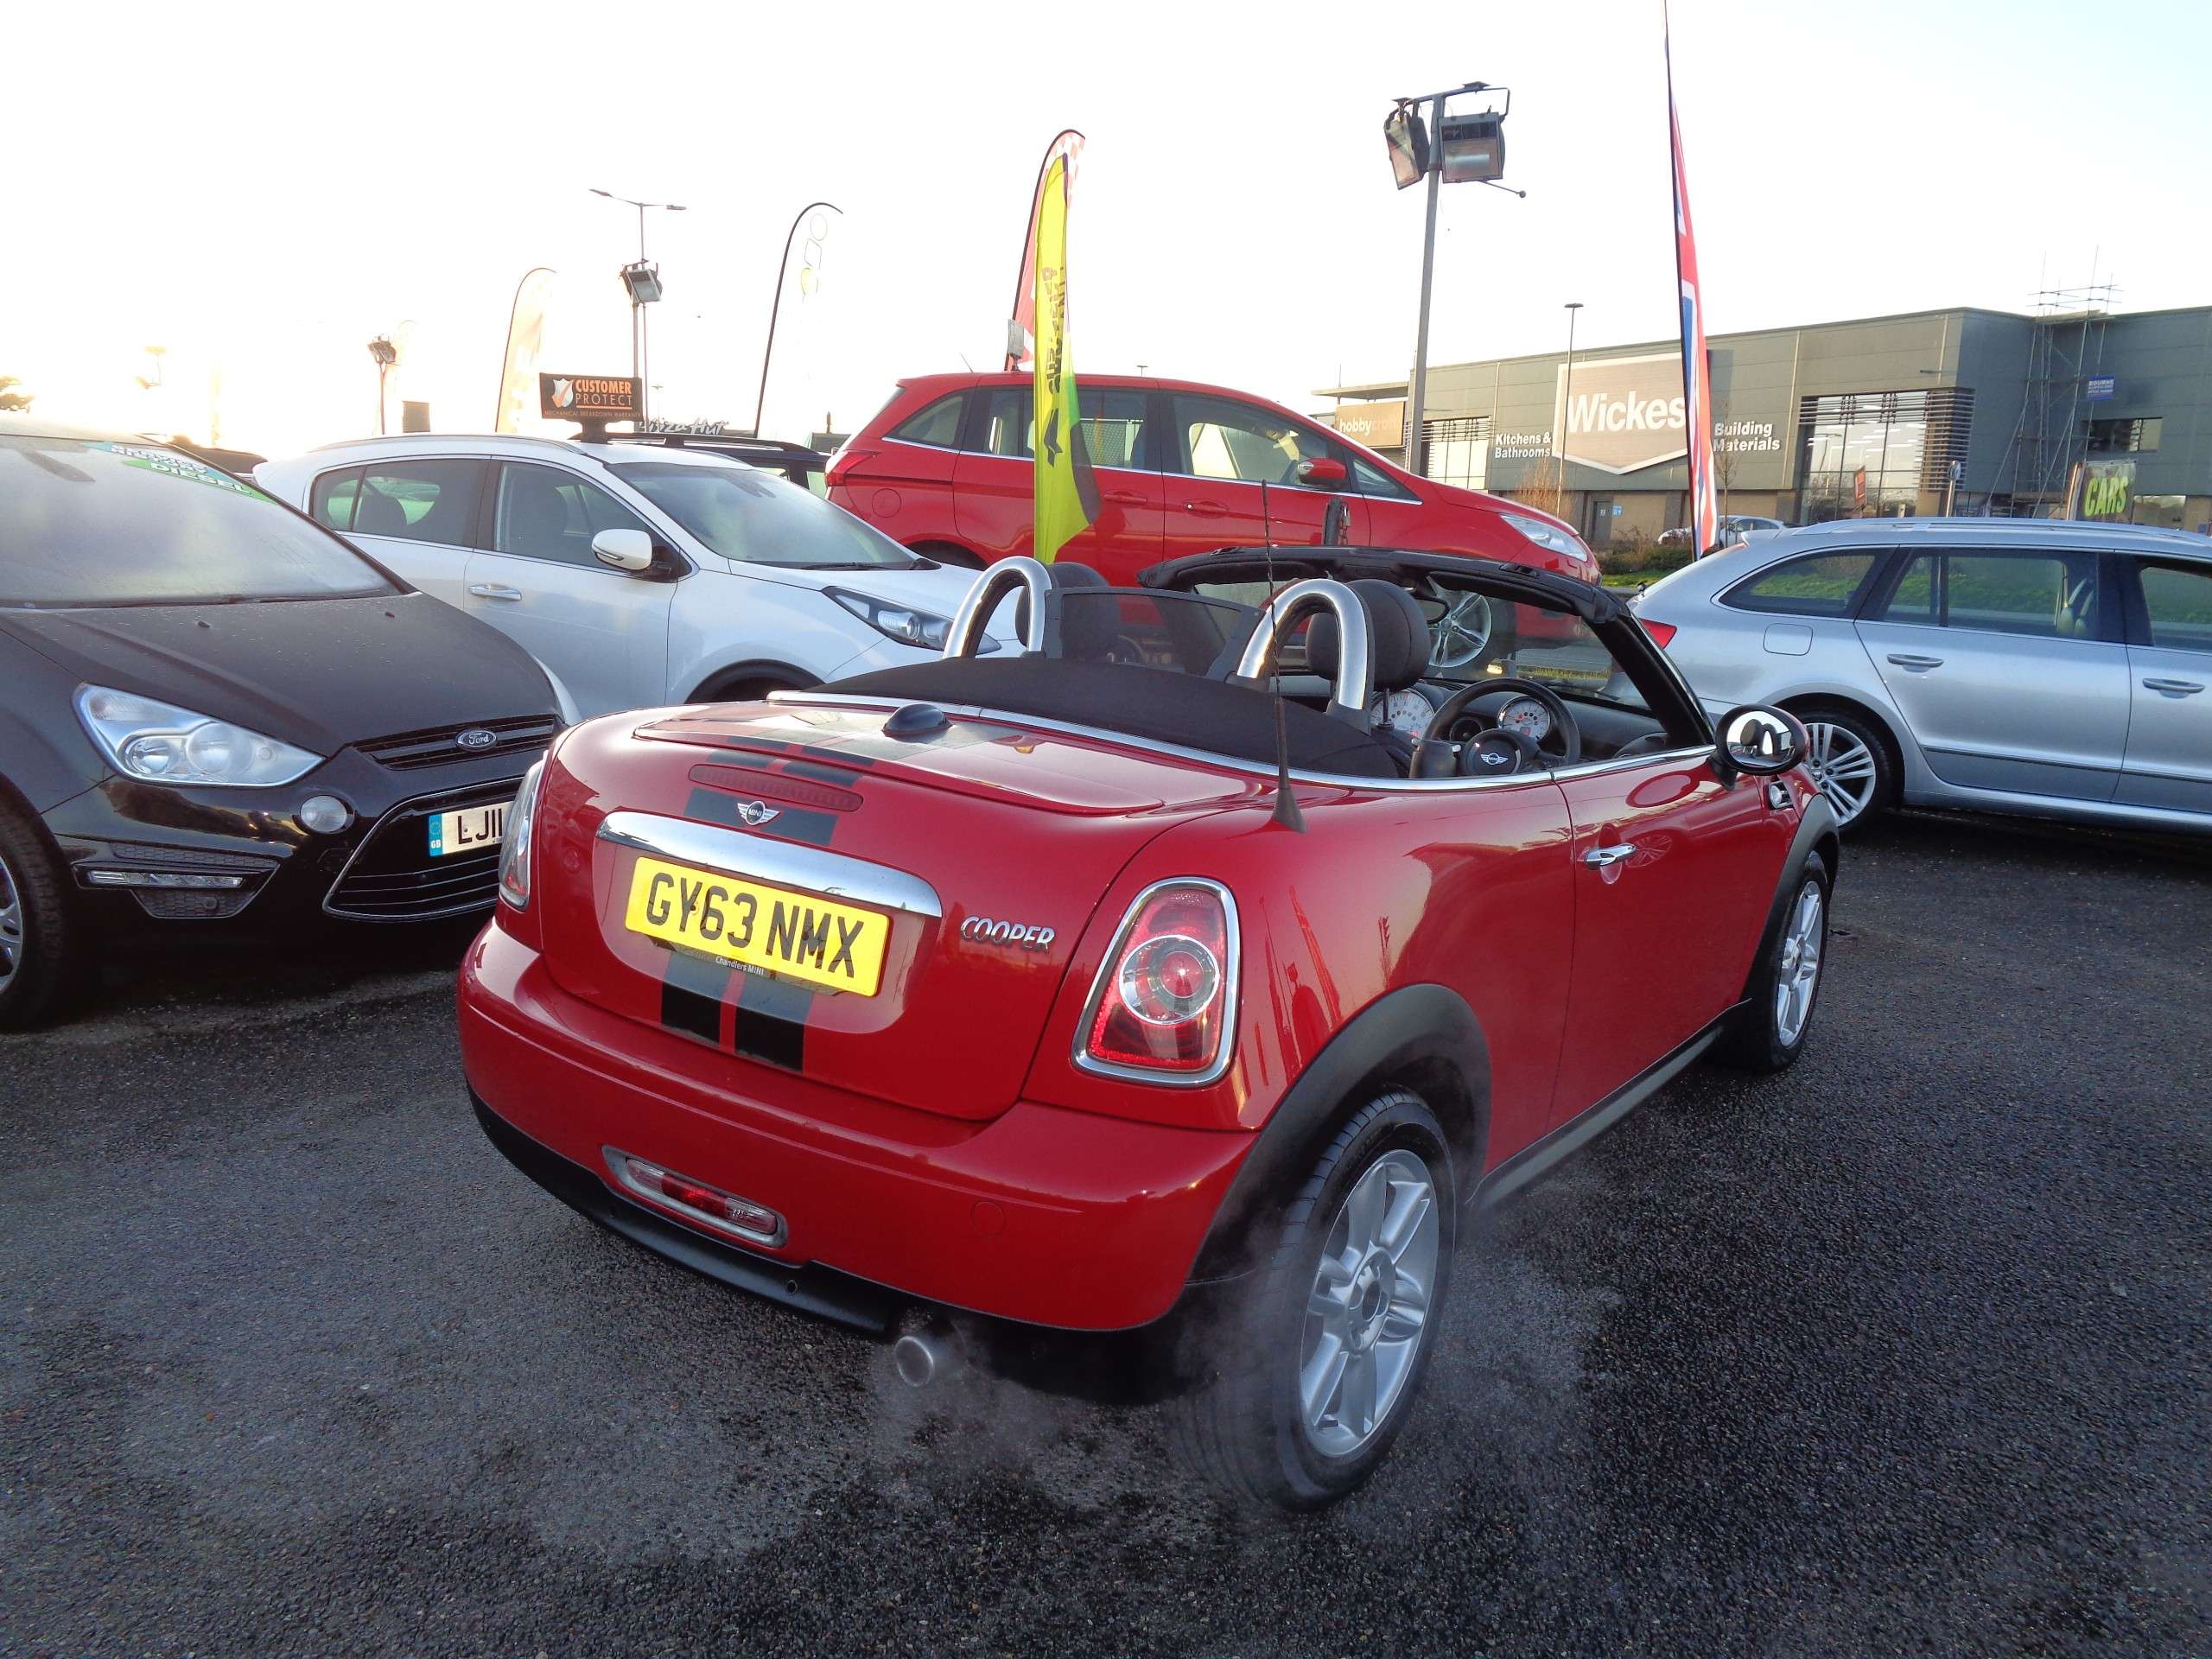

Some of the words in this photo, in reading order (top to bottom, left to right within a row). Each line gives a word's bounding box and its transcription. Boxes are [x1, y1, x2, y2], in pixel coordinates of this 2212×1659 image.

[575, 379, 632, 395] CUSTOMER
[575, 393, 632, 406] PROTECT
[1567, 391, 1686, 433] Wickes
[1714, 421, 1773, 436] Building
[1496, 433, 1541, 445] Kitchens
[1542, 432, 1552, 443] &
[1713, 437, 1781, 452] Materials
[1495, 447, 1551, 458] Bathrooms
[149, 462, 253, 496] DIESEL
[2084, 476, 2129, 517] CARS
[468, 733, 490, 745] Ford
[748, 808, 762, 817] MINI
[646, 873, 757, 949] GY63
[766, 900, 864, 978] NMX
[961, 916, 1055, 951] COOPER
[715, 956, 747, 971] Chandlers
[747, 964, 765, 976] MINI
